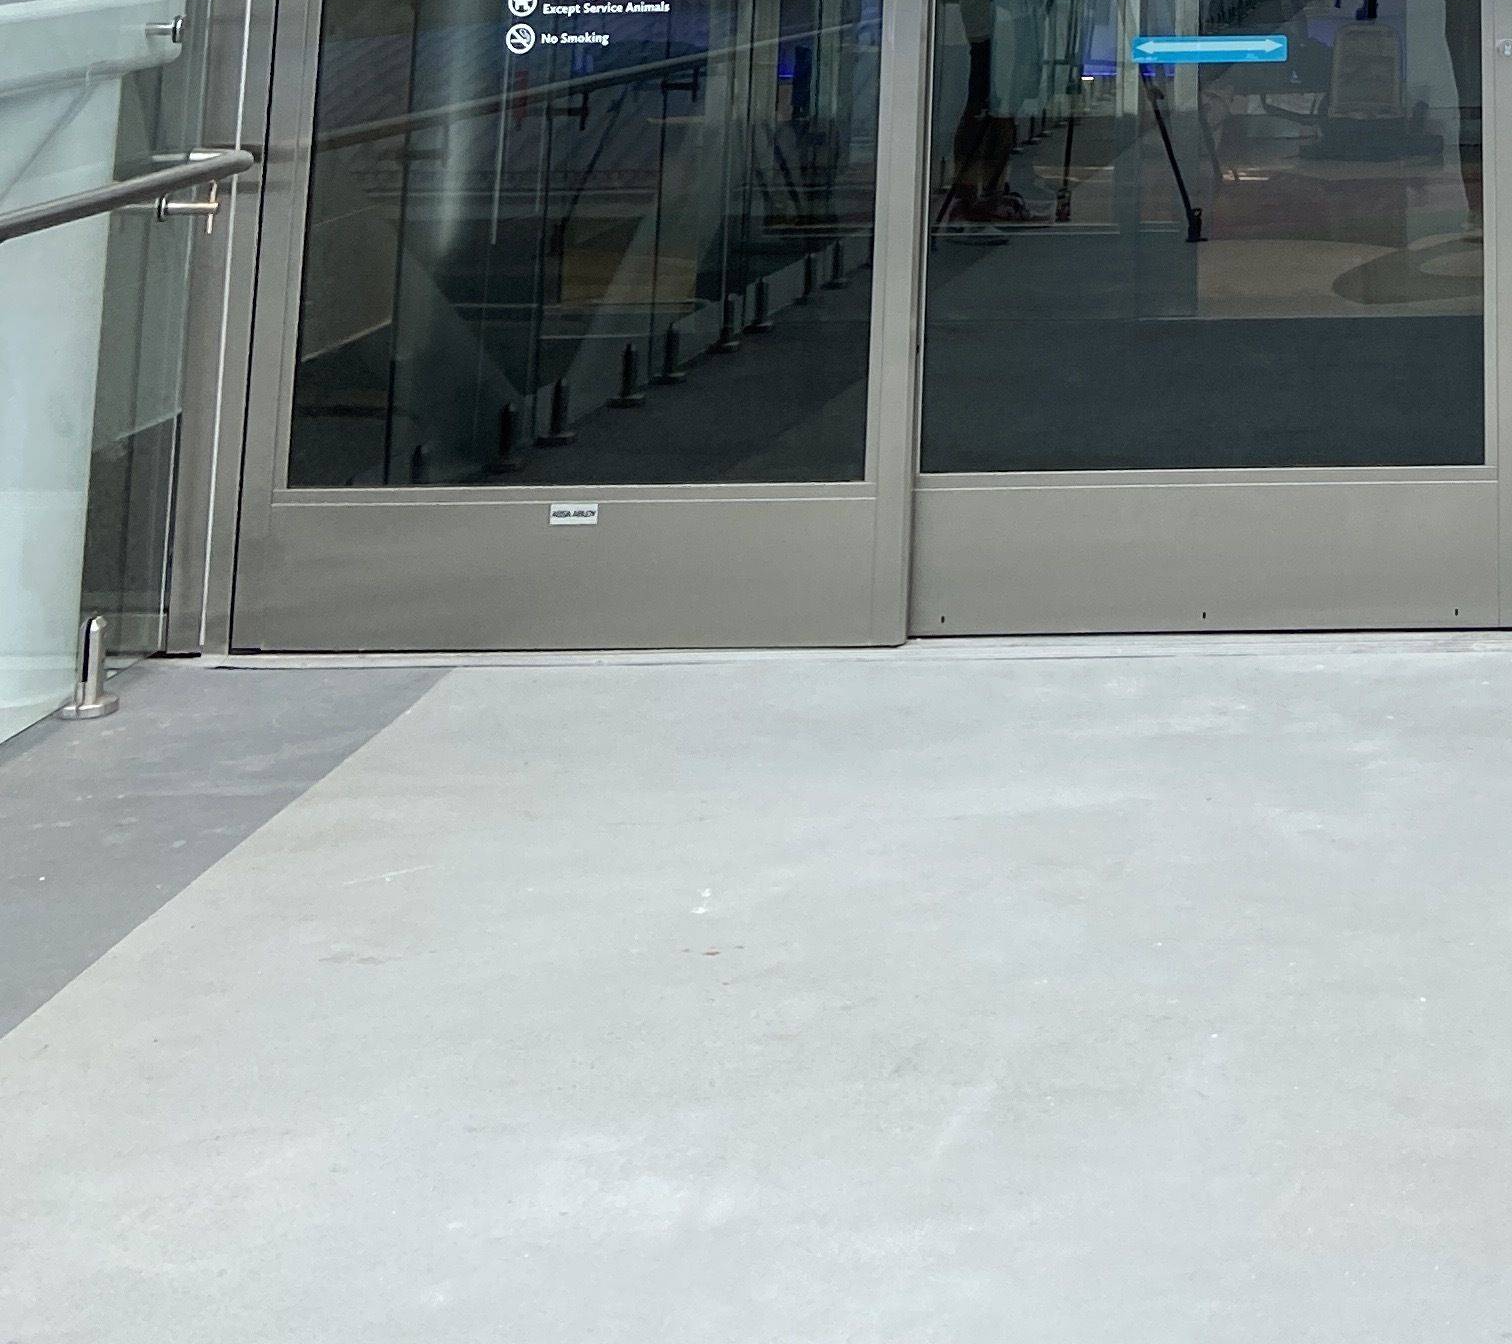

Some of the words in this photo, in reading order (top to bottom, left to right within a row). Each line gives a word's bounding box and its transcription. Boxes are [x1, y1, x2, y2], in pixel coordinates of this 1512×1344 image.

[542, 3, 581, 17] Except
[583, 1, 624, 14] Service
[625, 1, 670, 13] Animals
[541, 32, 559, 44] No
[560, 31, 610, 46] Smoking
